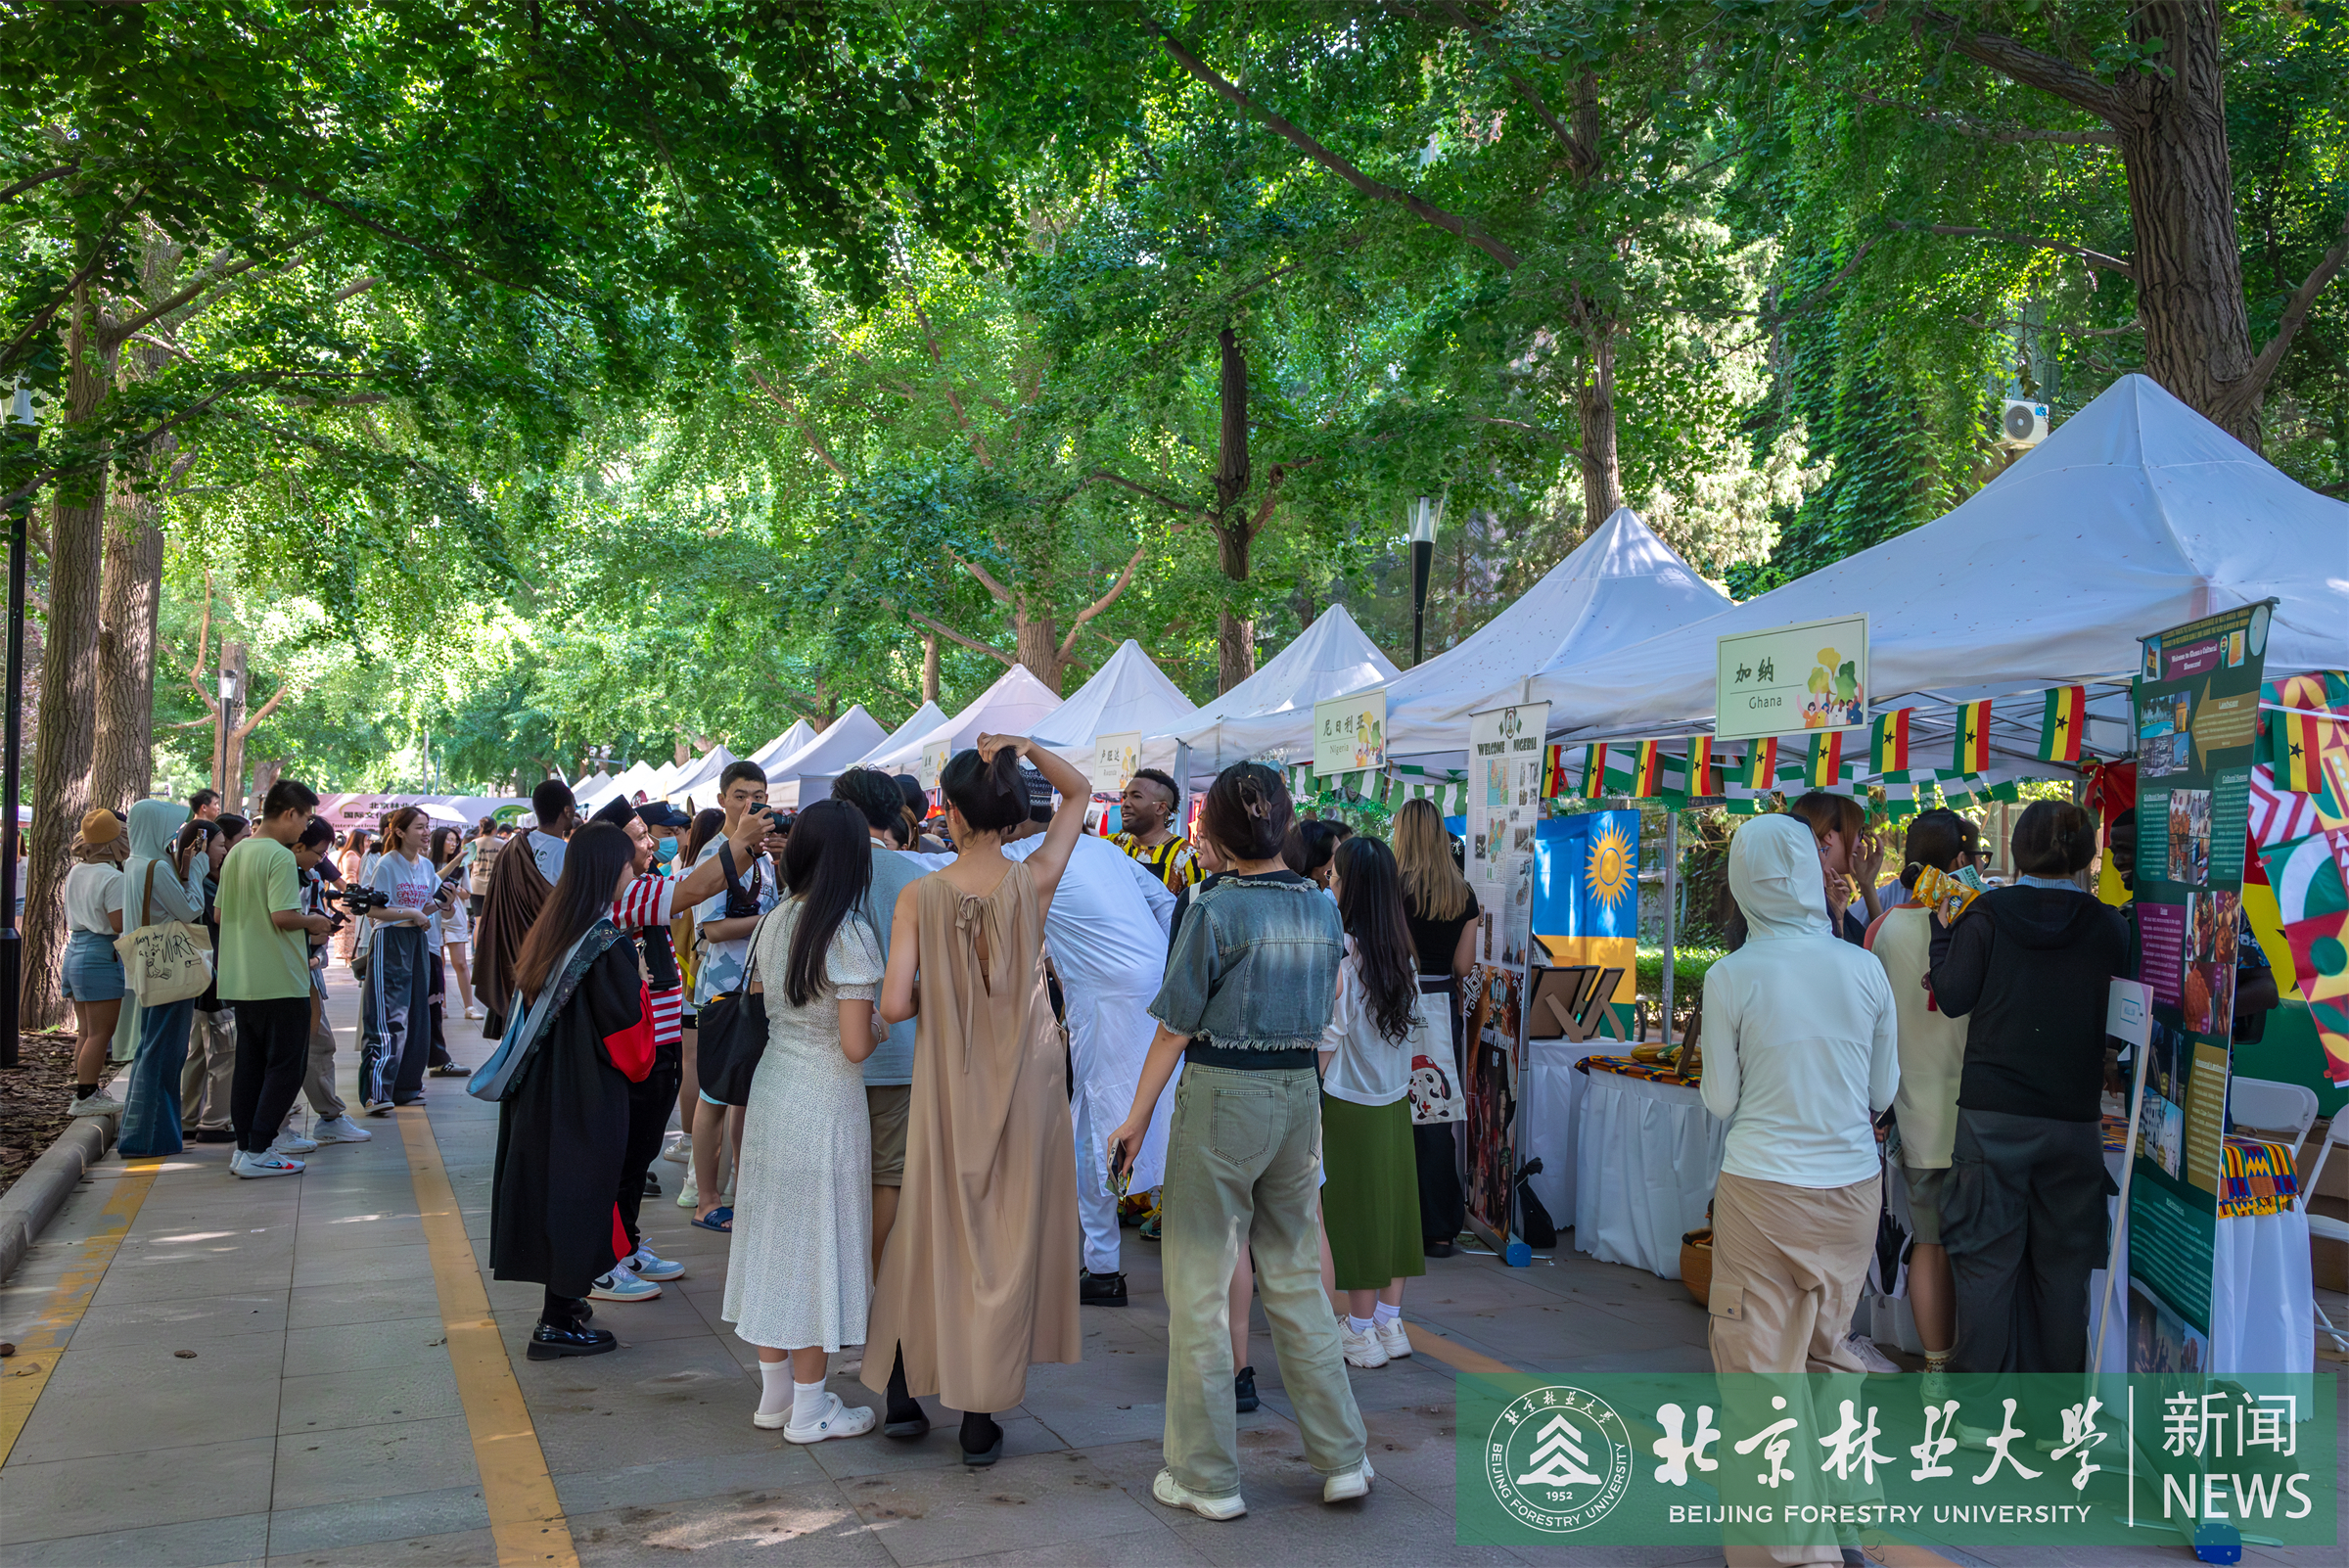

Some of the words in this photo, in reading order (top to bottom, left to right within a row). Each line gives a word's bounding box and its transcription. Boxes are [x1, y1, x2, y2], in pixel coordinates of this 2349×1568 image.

[1734, 656, 1774, 684] 加纳
[1749, 696, 1782, 710] Ghana
[1323, 714, 1365, 736] 尼日利亚
[1329, 743, 1350, 756] Nigeria
[1477, 740, 1505, 757] WELCOME
[1513, 736, 1538, 753] NIGERIA
